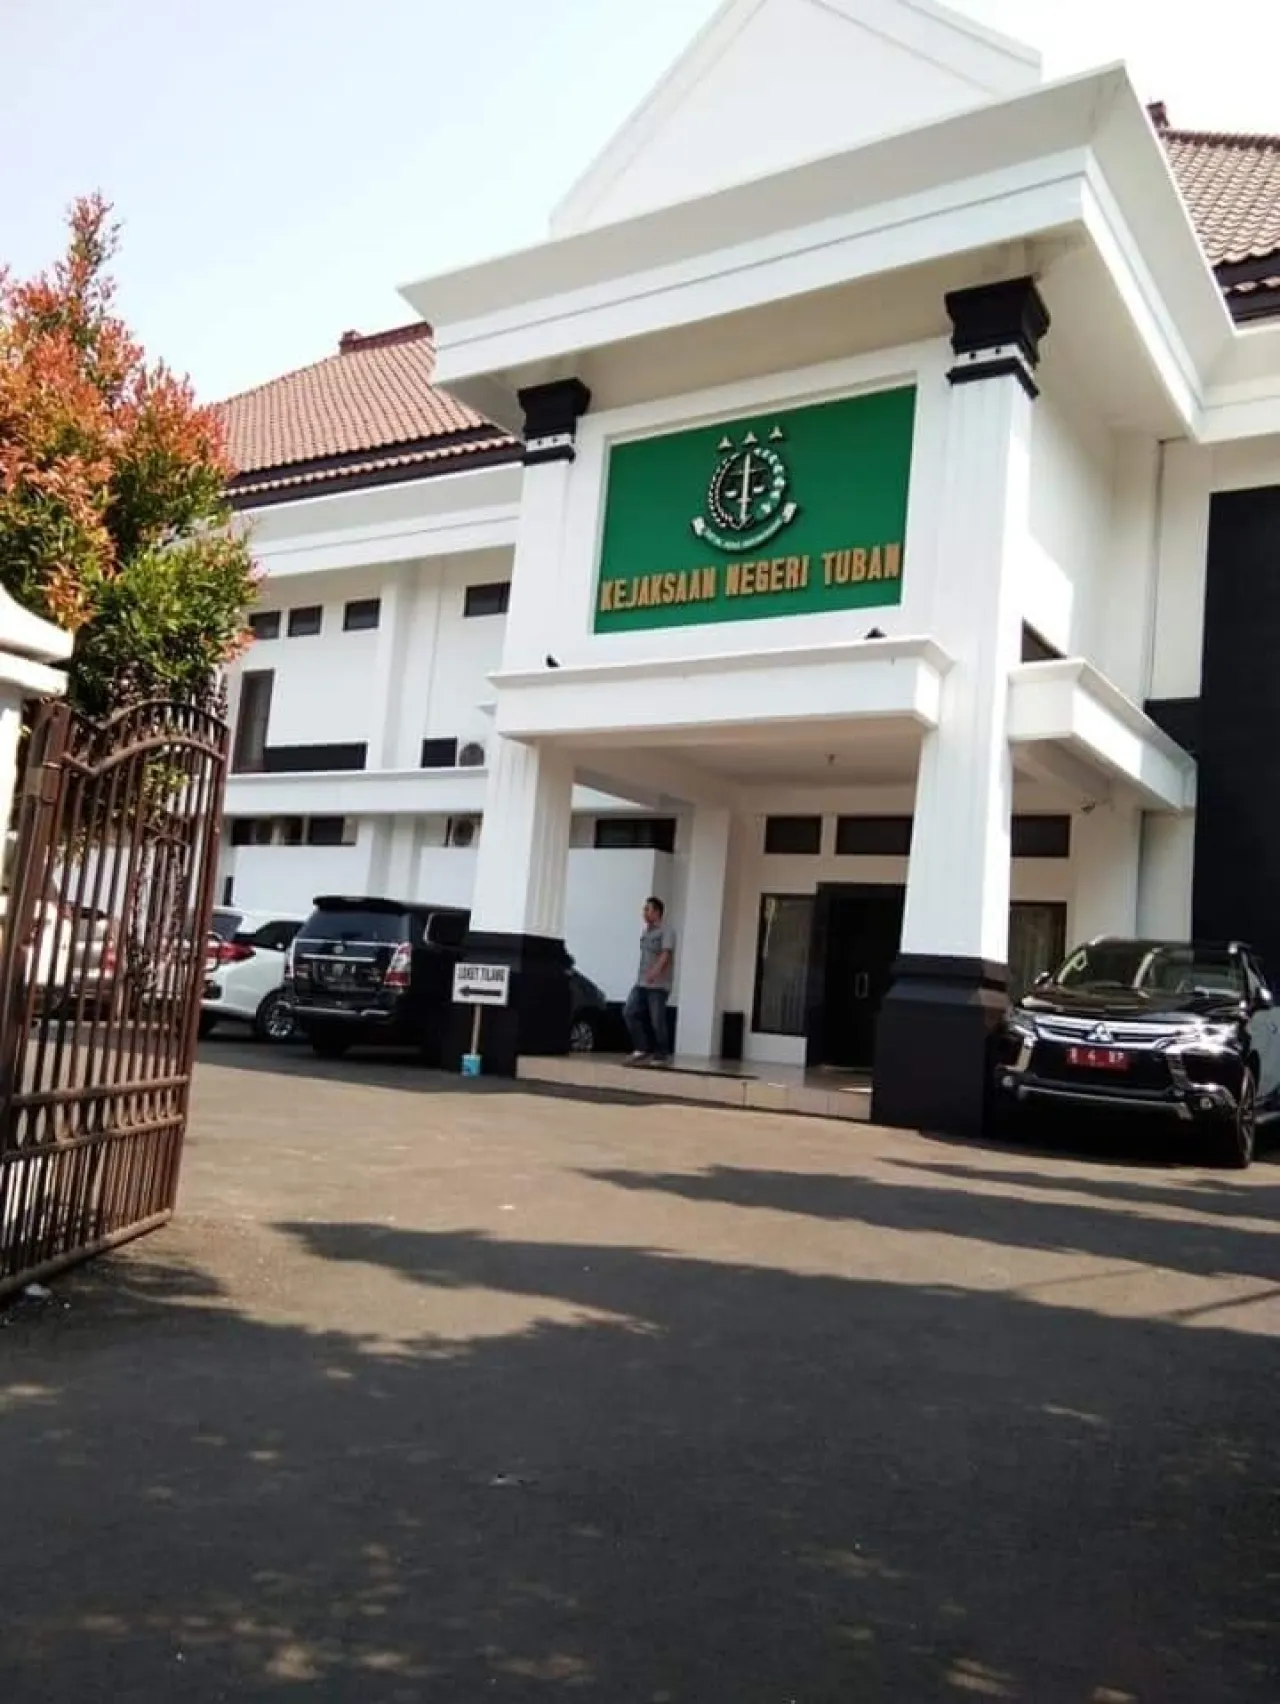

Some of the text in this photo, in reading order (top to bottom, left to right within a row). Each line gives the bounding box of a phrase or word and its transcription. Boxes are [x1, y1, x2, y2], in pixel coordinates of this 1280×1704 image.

[600, 542, 901, 611] KEJAKSAAN NEGERI TUBAN
